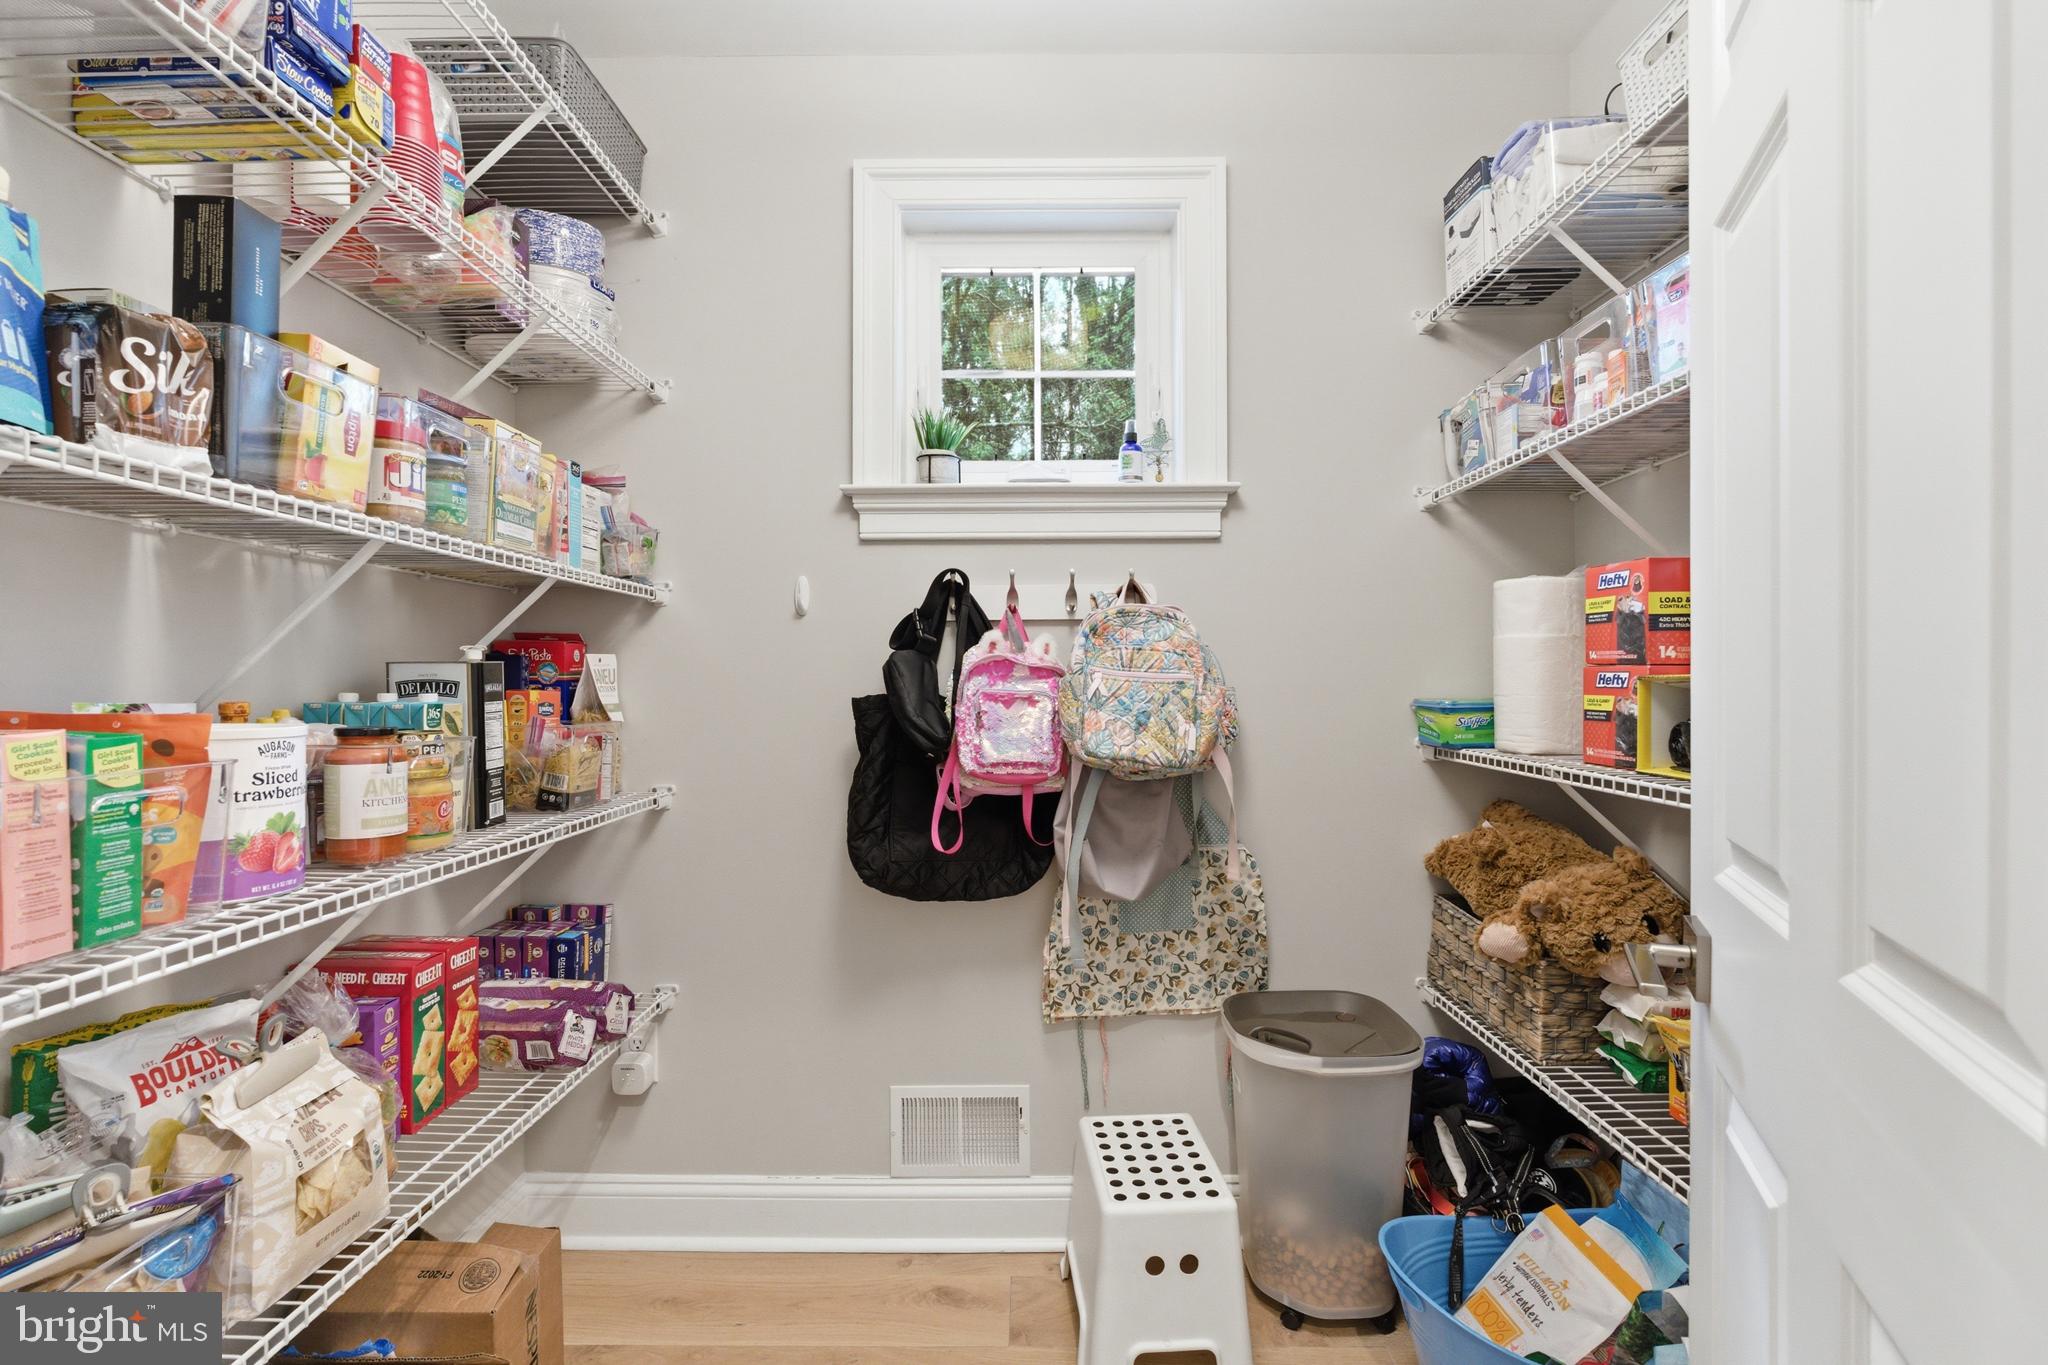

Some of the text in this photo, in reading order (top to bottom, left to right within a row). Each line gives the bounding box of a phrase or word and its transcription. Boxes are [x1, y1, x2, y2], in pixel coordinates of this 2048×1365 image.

[276, 57, 303, 83] Slow
[303, 76, 334, 107] Cooker
[109, 336, 197, 396] Silk
[347, 412, 359, 452] Lipton
[1600, 574, 1627, 587] Hefty
[1659, 645, 1677, 658] 14
[1597, 673, 1627, 686] Hefty
[400, 682, 456, 695] DELALLO
[427, 707, 441, 719] 365
[11, 744, 30, 754] Girl
[97, 752, 113, 760] Girl
[257, 740, 296, 756] AUGASON
[14, 757, 52, 771] proceeds
[251, 769, 298, 786] Sliced
[233, 784, 306, 803] trawberri
[450, 946, 477, 970] CHEEZ-IT
[334, 972, 357, 985] NEED
[372, 972, 408, 985] CHEEZ-IT
[415, 962, 443, 988] CHEEZ-IT
[163, 1066, 226, 1098] CANYON
[298, 1118, 327, 1143] CHIPS
[330, 1123, 349, 1138] corn
[1492, 1270, 1544, 1328] jerky tenders
[1472, 1293, 1513, 1342] 100%
